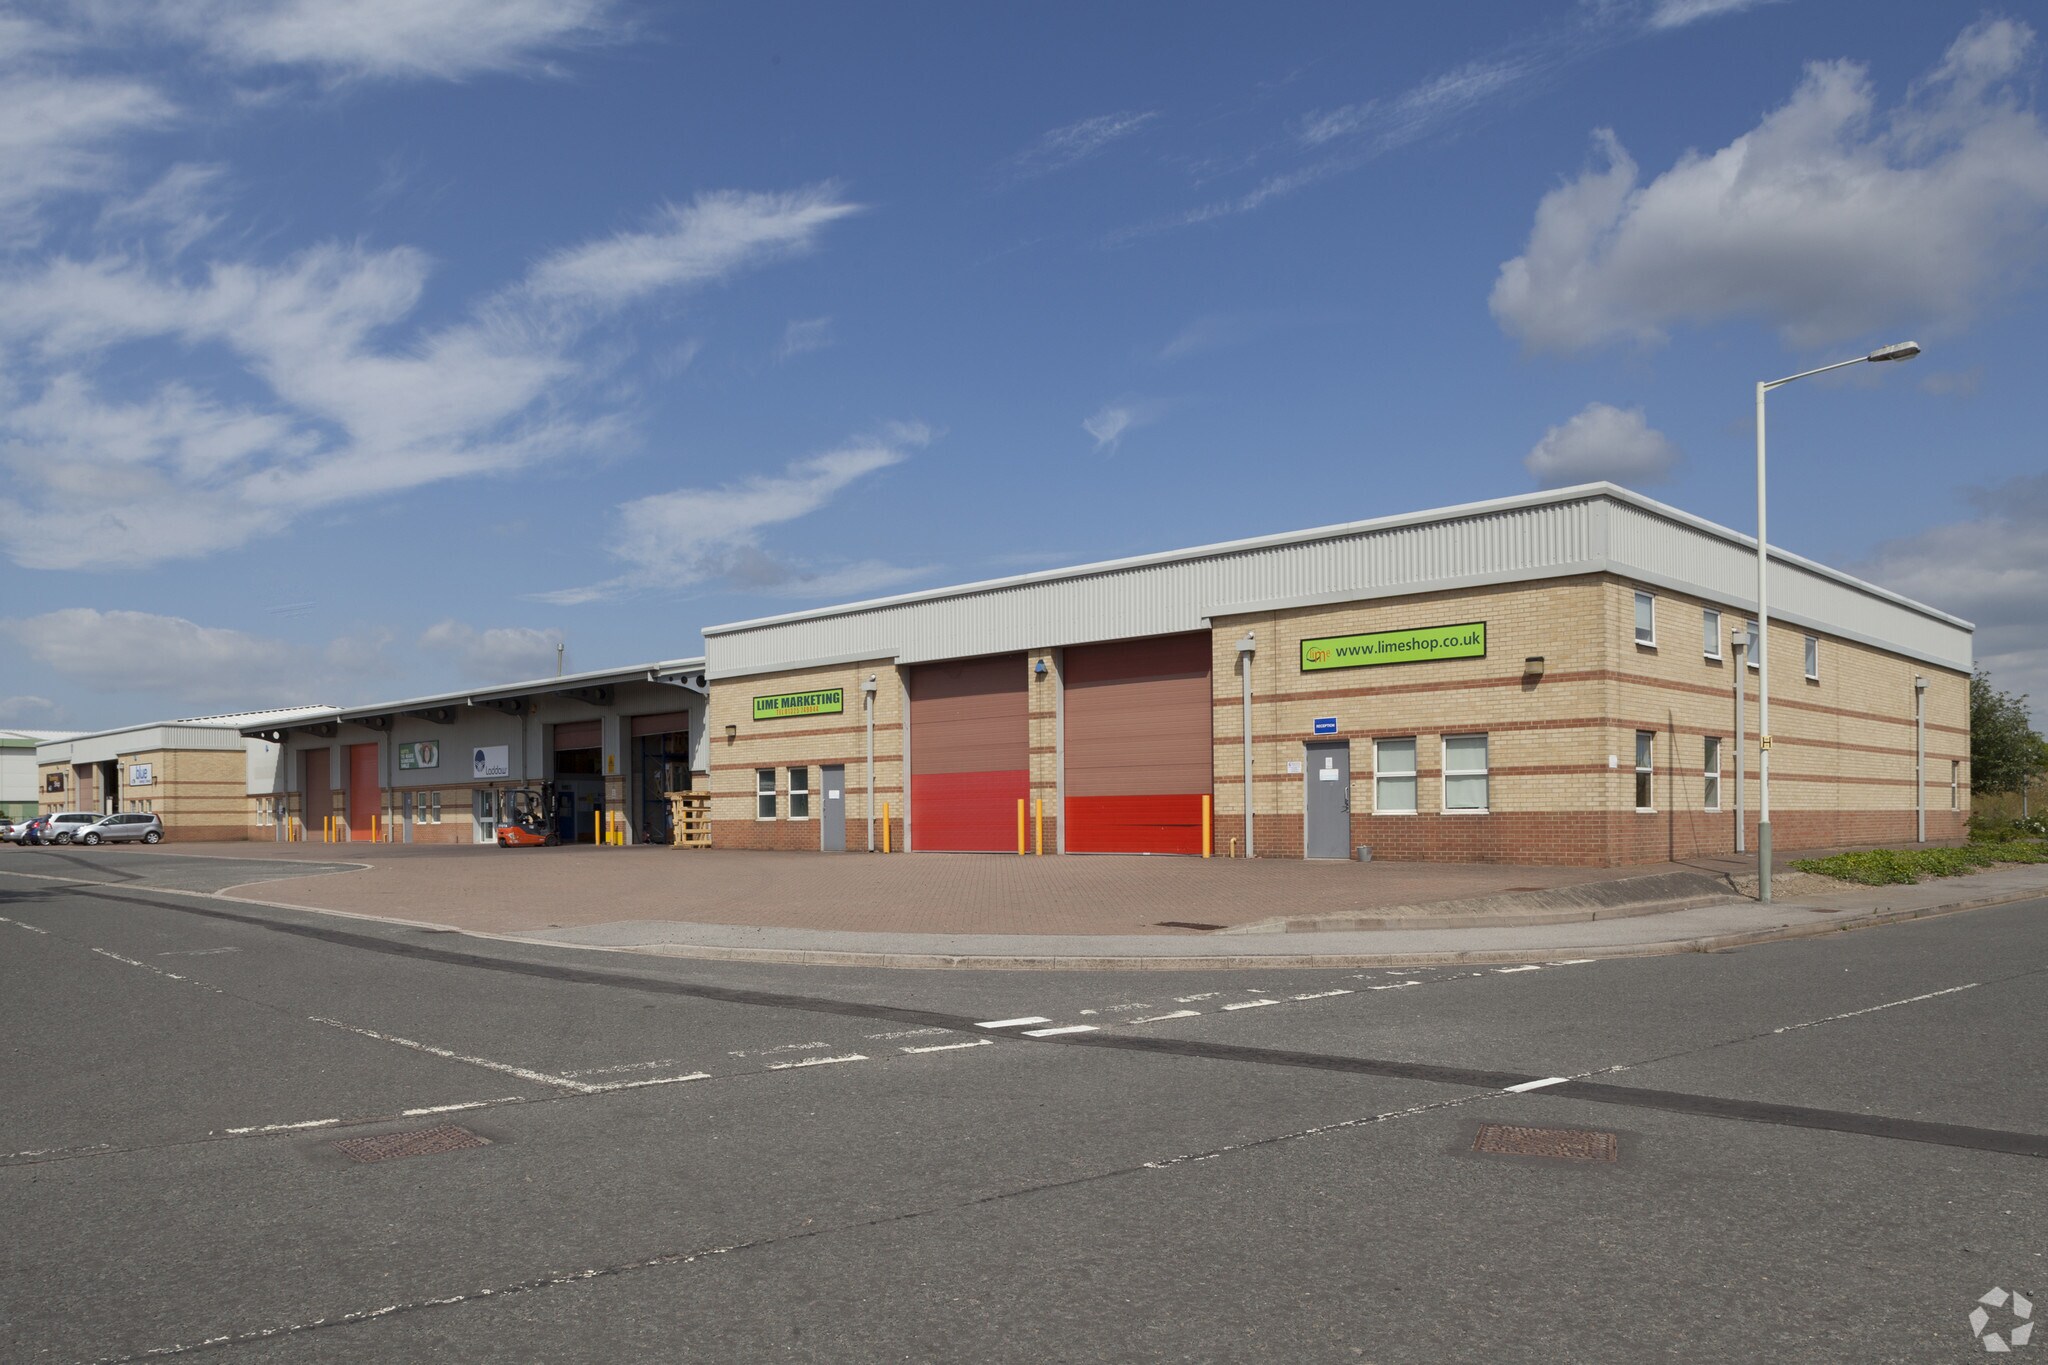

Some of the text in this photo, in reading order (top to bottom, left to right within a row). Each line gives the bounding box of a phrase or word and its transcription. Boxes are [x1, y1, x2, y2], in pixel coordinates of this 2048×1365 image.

[1336, 632, 1480, 657] www.limeshop.co.uk
[757, 698, 779, 711] LIME
[781, 692, 840, 709] MARKETING
